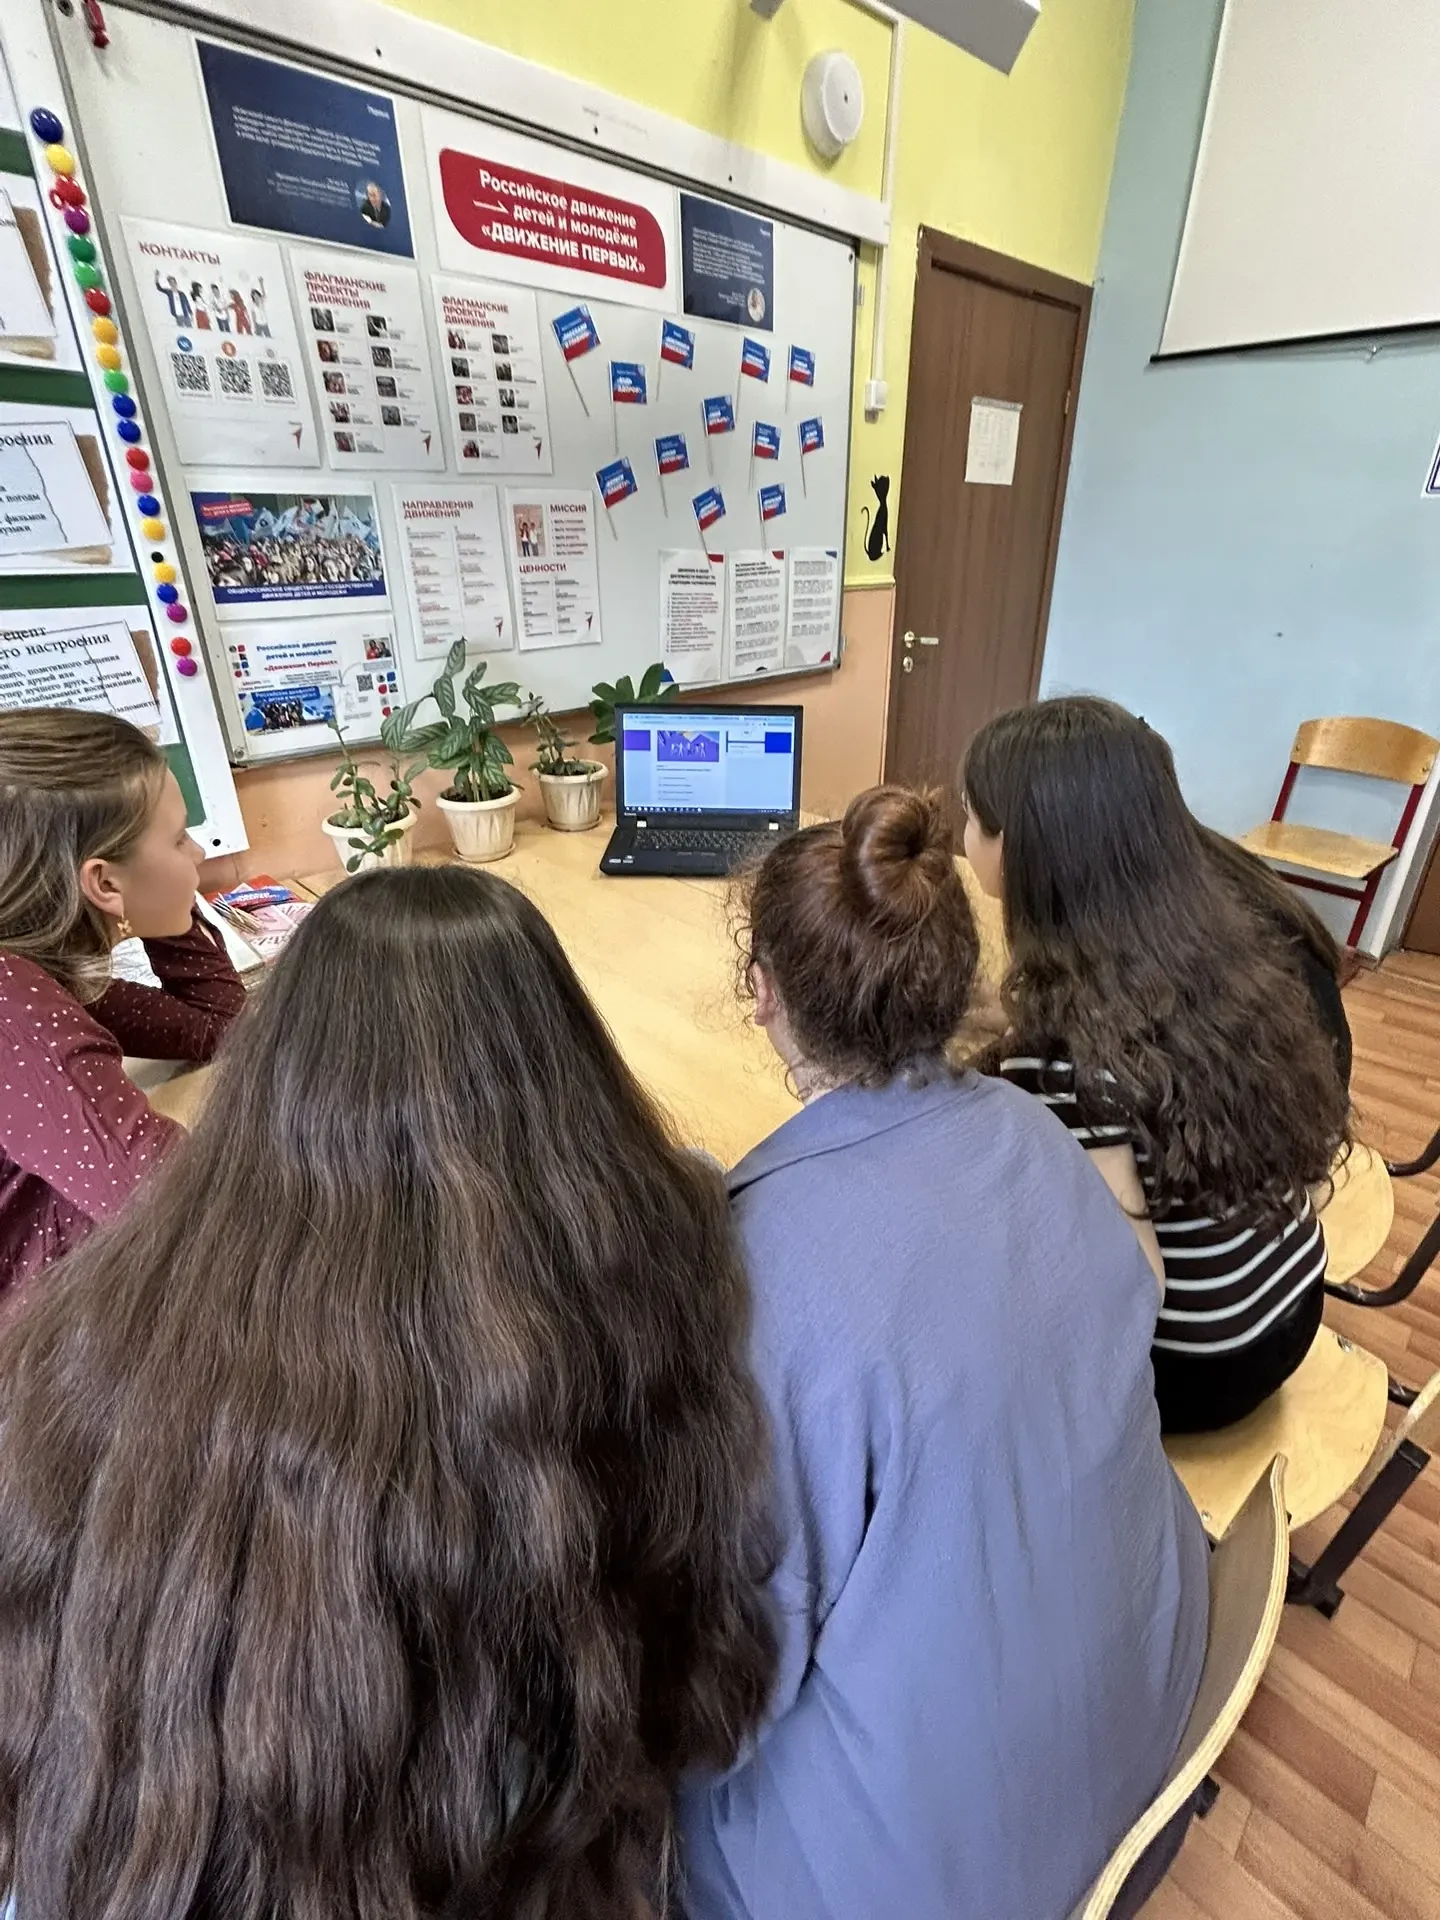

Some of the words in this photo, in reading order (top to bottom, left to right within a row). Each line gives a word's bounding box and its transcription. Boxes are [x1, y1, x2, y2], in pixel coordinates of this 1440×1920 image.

[479, 169, 568, 211] Российское
[571, 199, 637, 230] движение
[513, 204, 555, 228] детей
[558, 217, 567, 230] и
[571, 219, 638, 249] молодёжи
[138, 240, 220, 265] КОНТАКТЫ
[481, 221, 580, 259] «ДВИЖЕНИЕ
[582, 243, 646, 273] ПЕРВЫХ»
[303, 270, 387, 293] ФЛАГМАНСКИЕ
[305, 281, 360, 297] ПРОЕКТЫ
[308, 292, 371, 310] ДВИЖЕНИЯ
[441, 296, 509, 313] ФЛАГМАНСКИЕ
[443, 305, 487, 318] ПРОЕКТЫ
[444, 315, 496, 329] ДВИЖЕНИЯ
[402, 500, 474, 509] НАПРАВЛЕНИЯ
[550, 503, 587, 513] МИССИЯ
[404, 509, 461, 519] ДВИЖЕНИЯ
[519, 563, 567, 574] ЦЕННОСТИ
[26, 633, 111, 655] настроения
